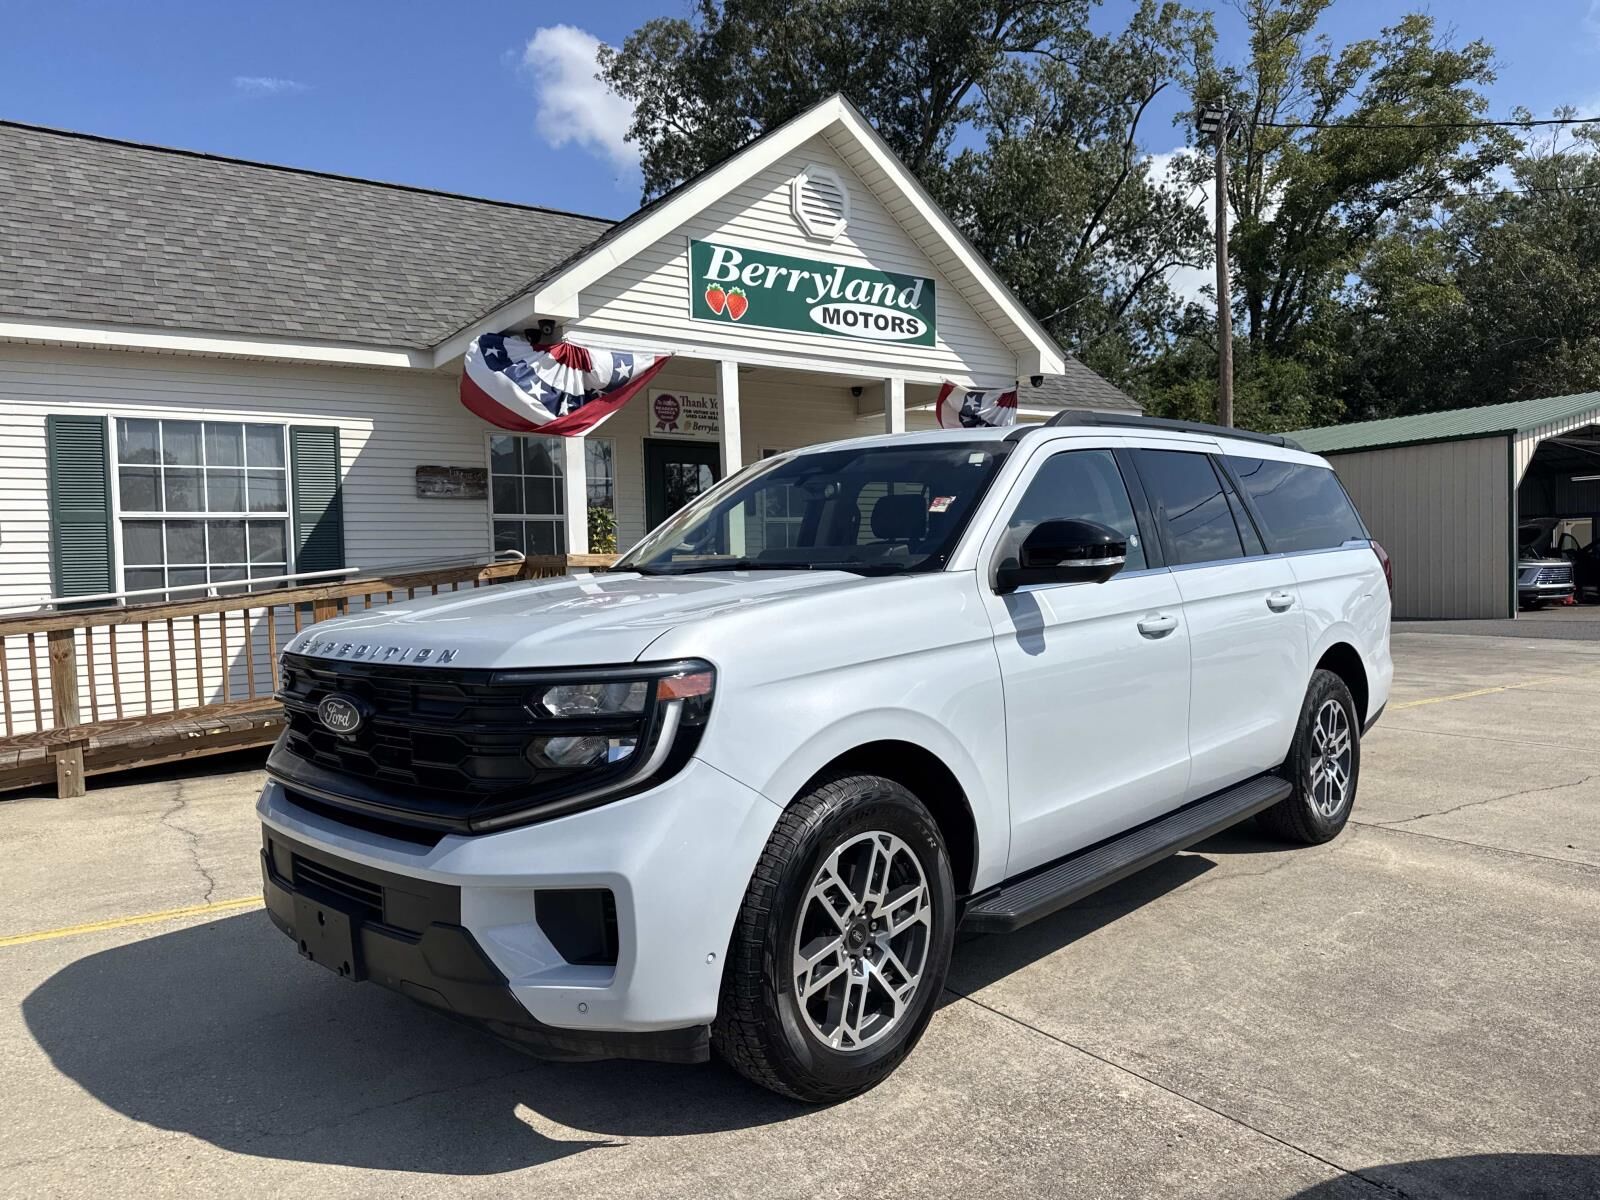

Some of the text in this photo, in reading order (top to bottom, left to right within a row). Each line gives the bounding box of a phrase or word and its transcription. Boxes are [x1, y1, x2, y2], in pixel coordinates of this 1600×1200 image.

[703, 245, 924, 310] Berryland
[822, 307, 919, 335] MOTORS
[680, 395, 708, 409] Thank
[709, 397, 718, 409] Yo
[692, 421, 719, 434] Berryla
[300, 639, 459, 663] EXPEDITION
[325, 701, 351, 728] Ford
